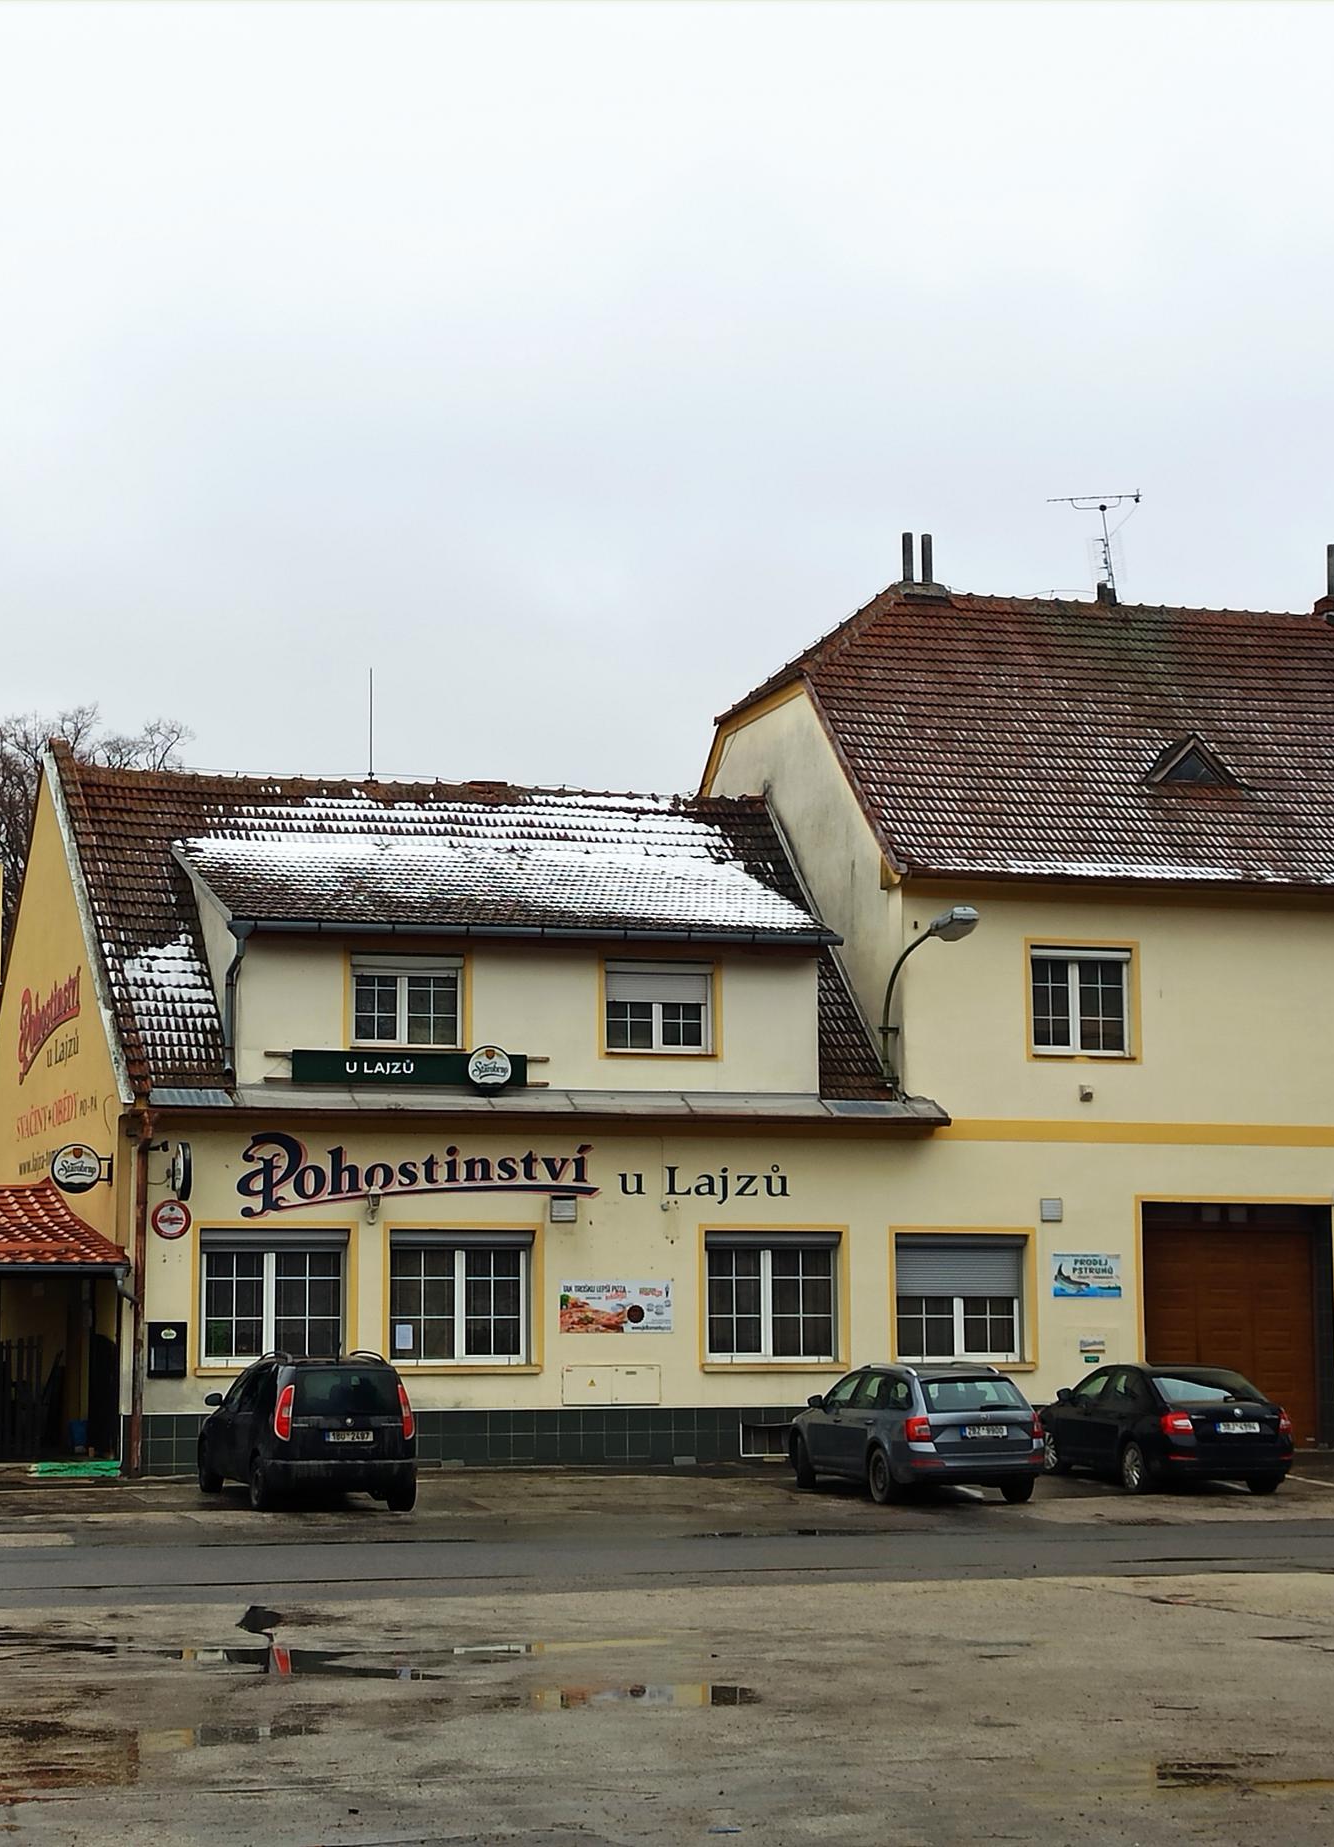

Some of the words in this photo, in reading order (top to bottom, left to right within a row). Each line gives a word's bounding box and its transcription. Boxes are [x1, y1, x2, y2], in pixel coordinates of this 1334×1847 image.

[345, 1061, 358, 1074] U
[363, 1058, 415, 1075] LAJZŮ
[236, 1132, 601, 1218] Pohostinství
[617, 1172, 647, 1195] u
[665, 1164, 791, 1205] Lajzů
[1073, 1258, 1109, 1266] PRODEJ
